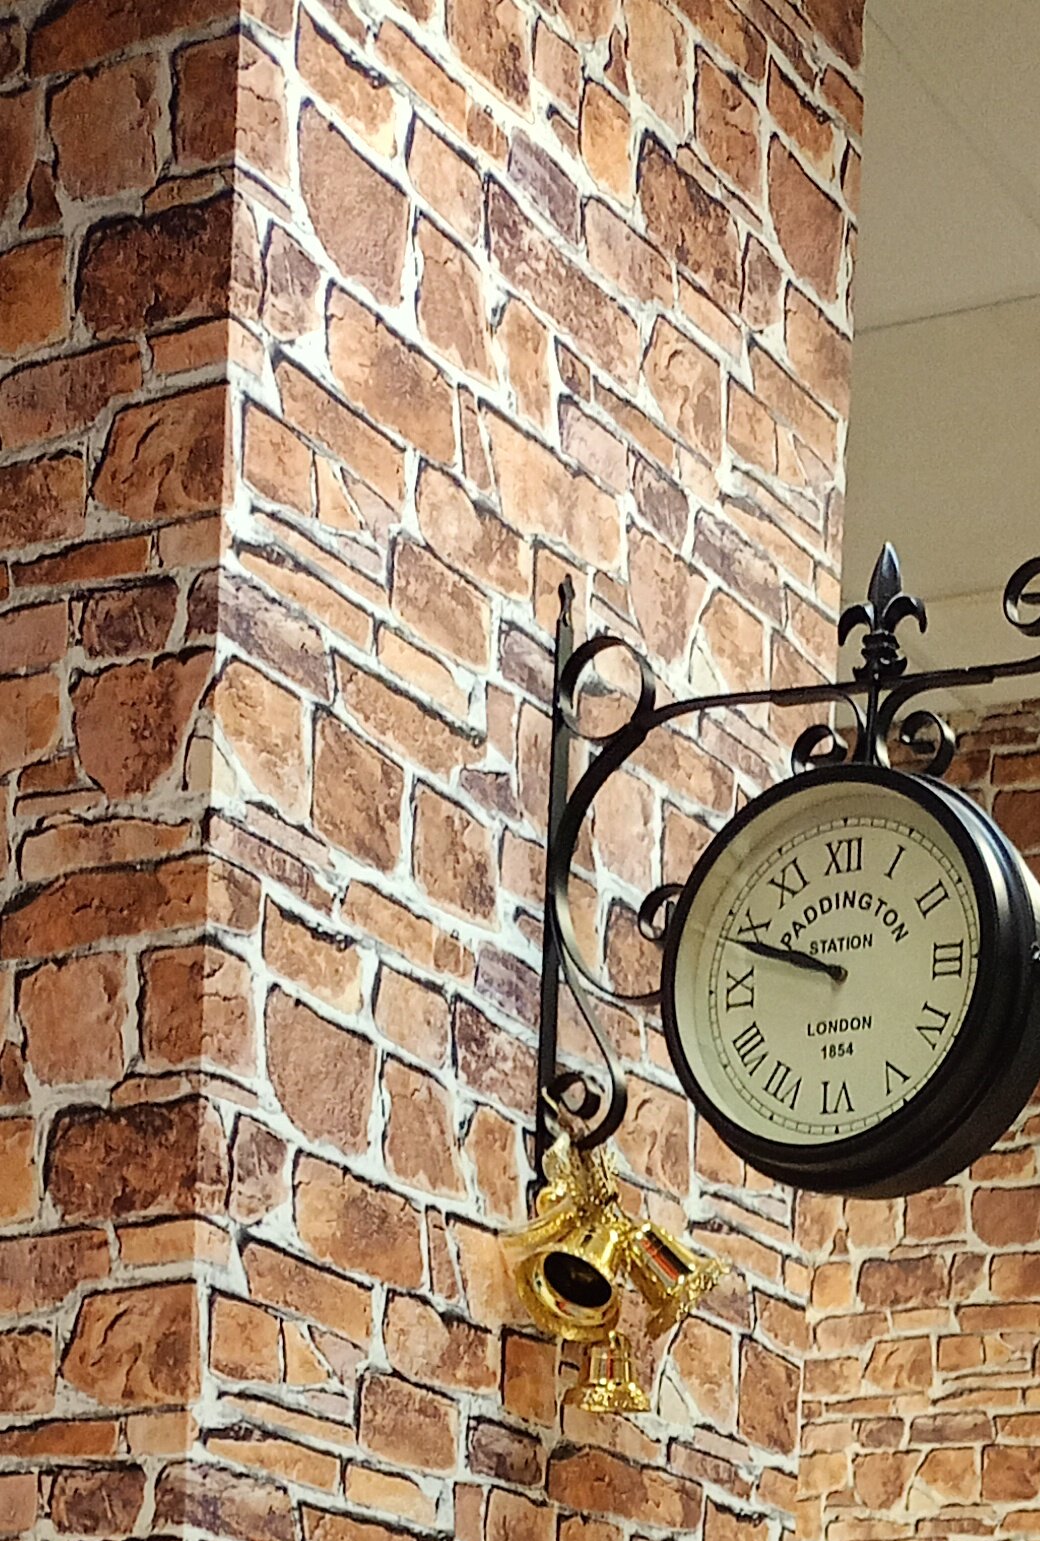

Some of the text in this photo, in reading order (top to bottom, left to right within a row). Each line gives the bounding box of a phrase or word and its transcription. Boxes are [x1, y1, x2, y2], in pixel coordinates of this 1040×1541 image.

[824, 837, 862, 876] XII
[767, 856, 810, 910] XI
[914, 878, 951, 920] II
[737, 908, 772, 945] X
[780, 890, 909, 951] PADDINGTON
[809, 933, 873, 955] STATION
[932, 939, 964, 981] III
[726, 965, 754, 1013] IX
[807, 1016, 872, 1037] LONDON
[916, 1001, 951, 1050] IV
[732, 1020, 769, 1076] VIII
[821, 1041, 854, 1060] 1854
[762, 1060, 802, 1110] VII
[820, 1081, 855, 1115] VI
[886, 1060, 912, 1097] V
